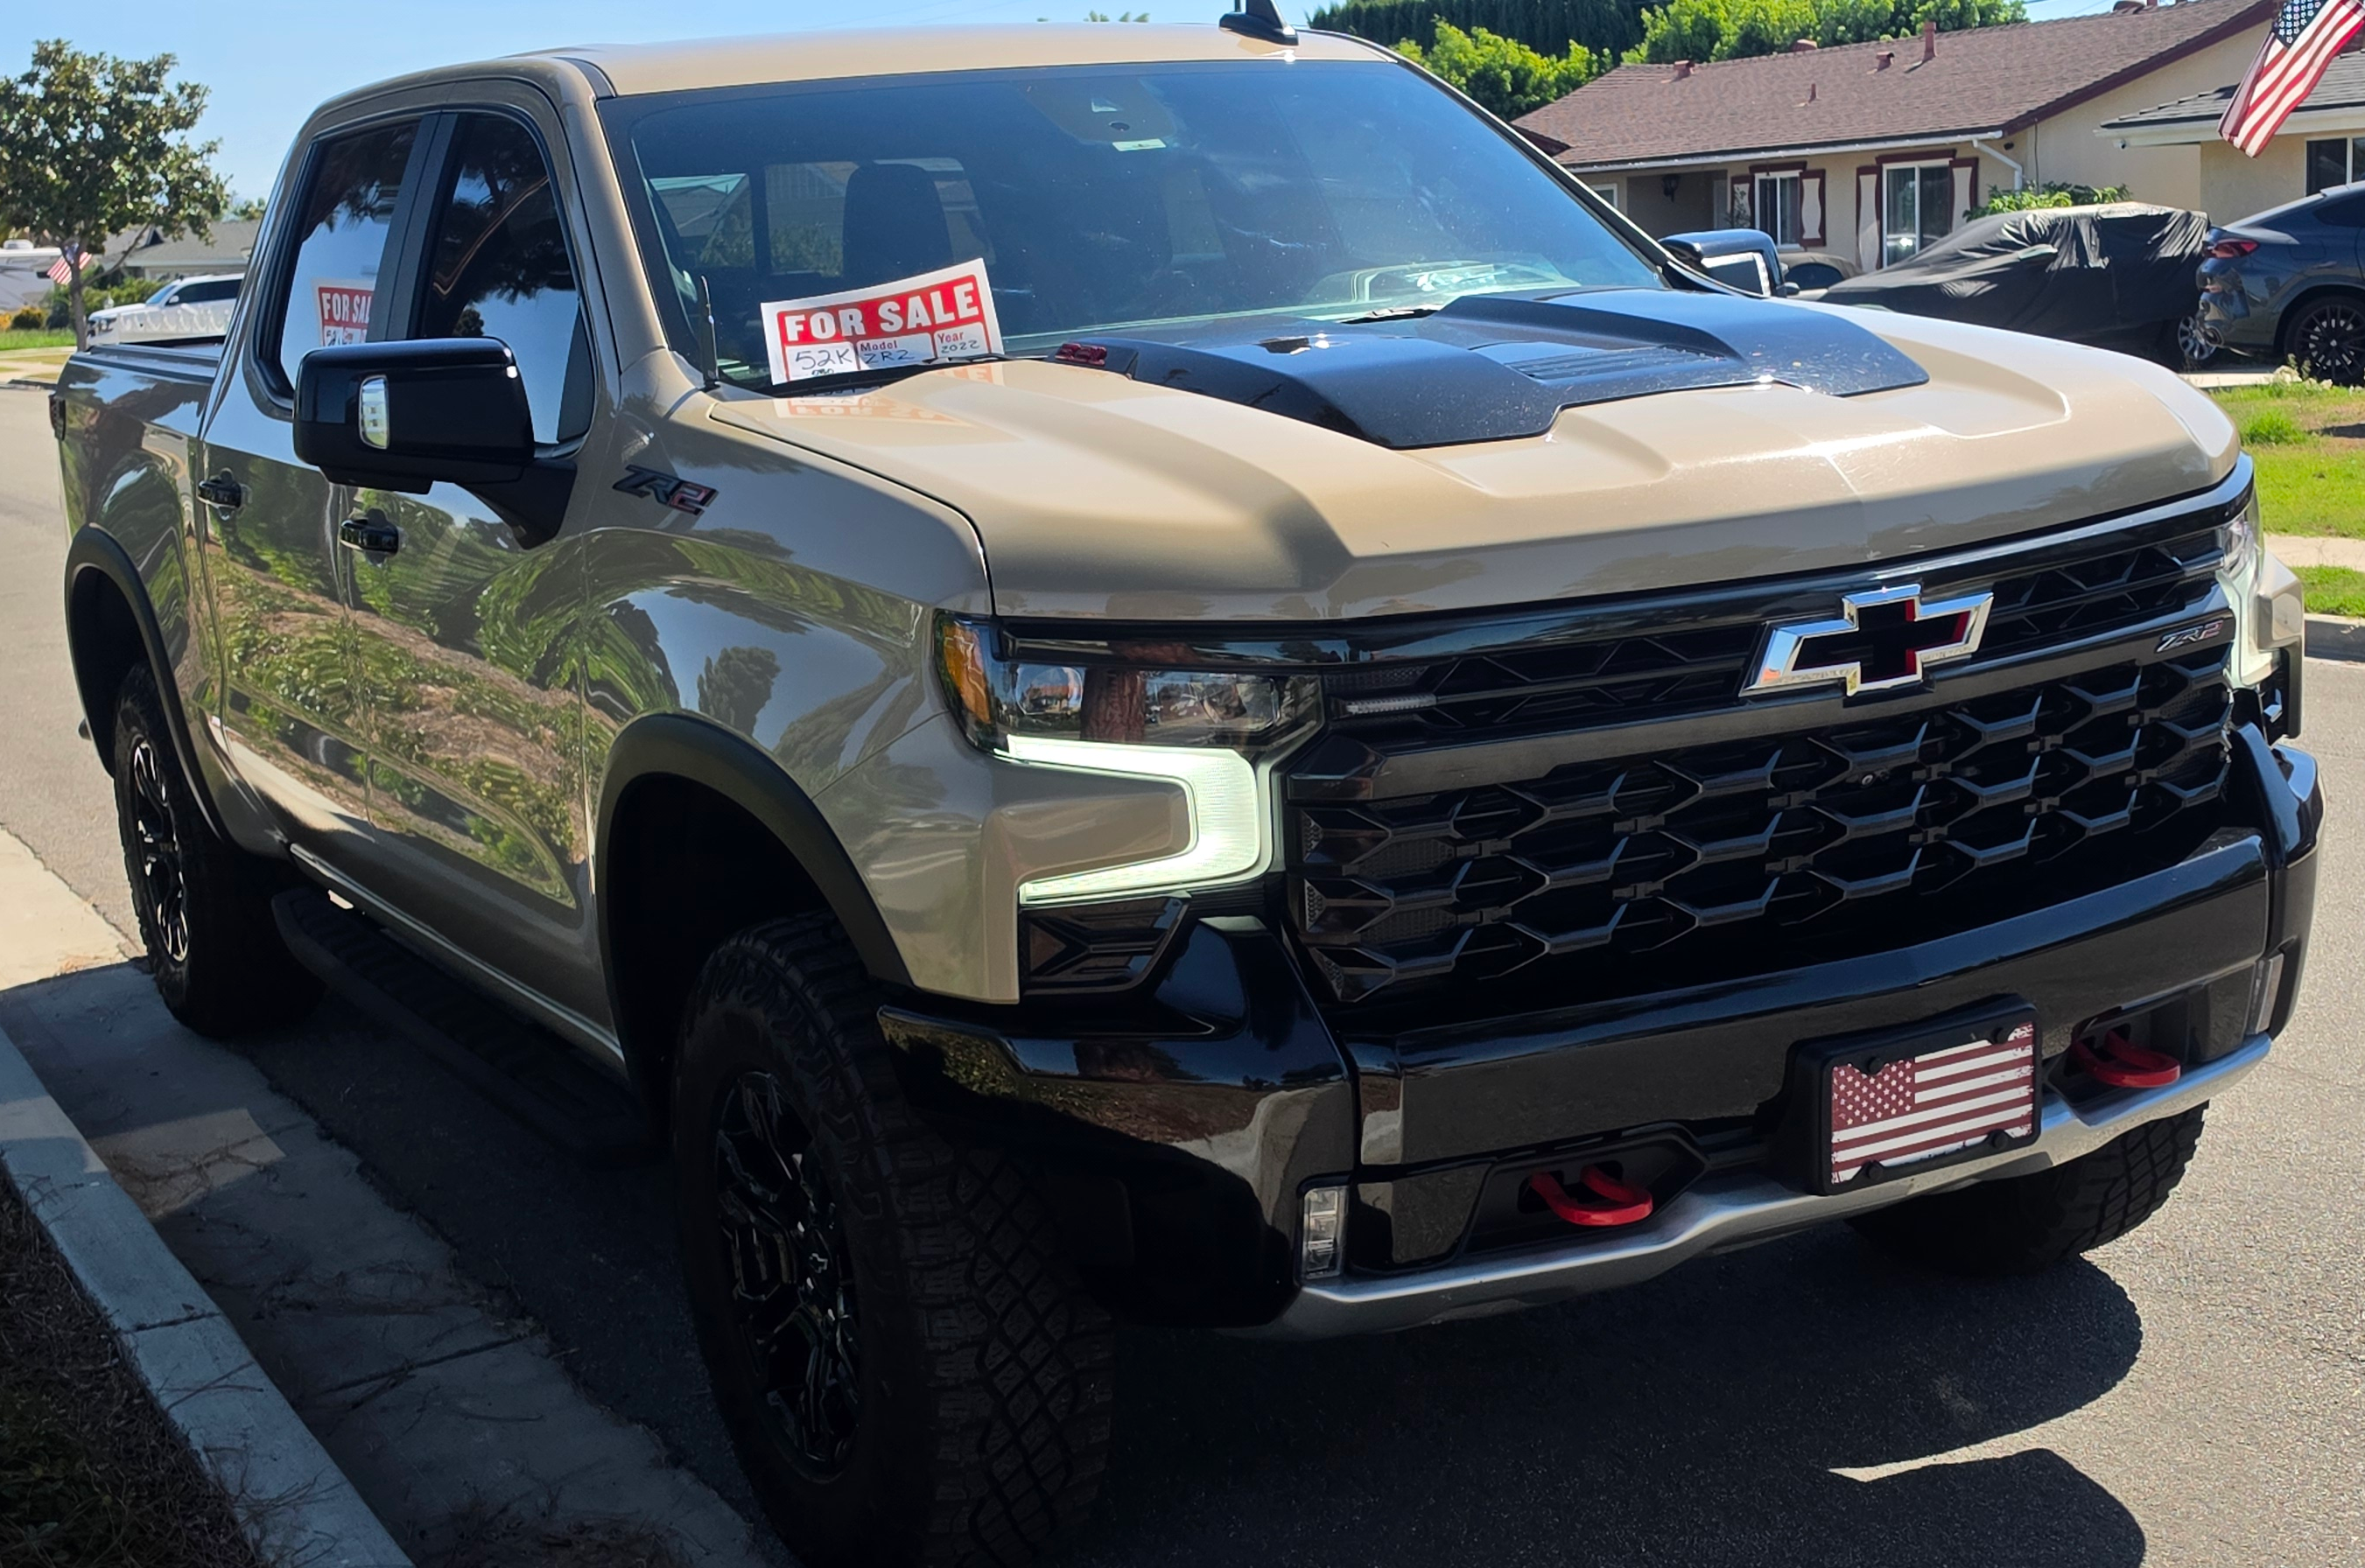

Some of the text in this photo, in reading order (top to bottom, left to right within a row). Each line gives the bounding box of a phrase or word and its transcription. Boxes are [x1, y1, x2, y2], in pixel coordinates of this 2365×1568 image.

[321, 292, 372, 324] FOR SAL
[784, 283, 979, 342] FOR SALE
[860, 340, 898, 352] Model
[937, 332, 965, 344] Year
[941, 340, 980, 354] 2022
[795, 348, 853, 370] 52K
[613, 464, 718, 515] ZR2
[2156, 620, 2223, 653] ZR2
